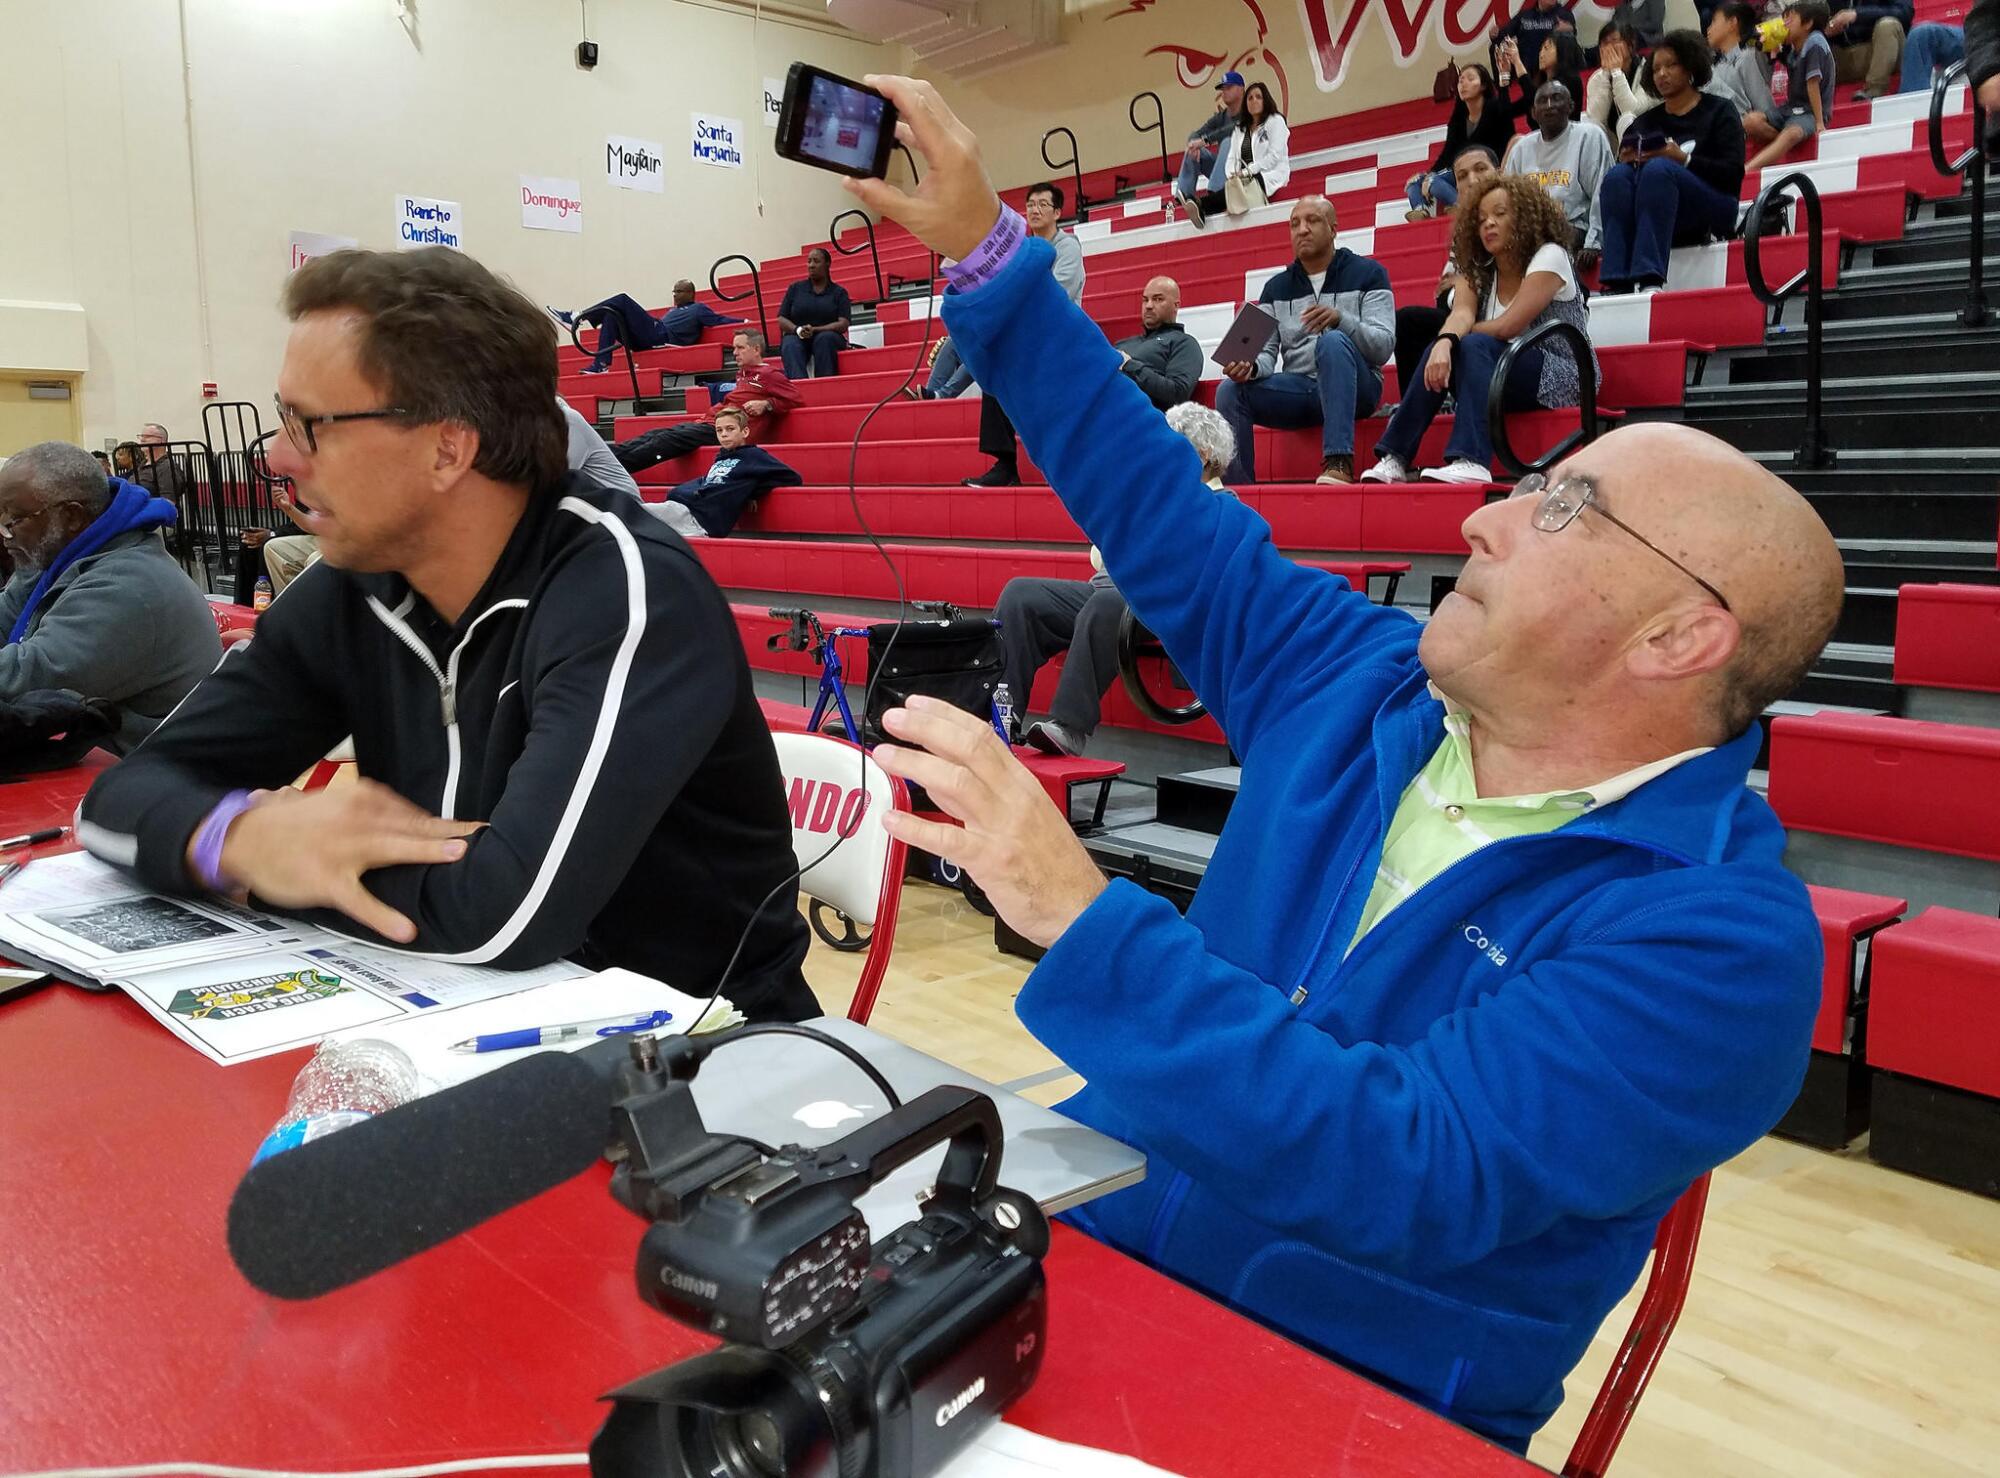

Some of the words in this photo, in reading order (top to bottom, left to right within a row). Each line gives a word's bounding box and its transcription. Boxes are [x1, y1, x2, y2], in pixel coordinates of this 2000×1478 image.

[697, 119, 732, 144] Santa
[607, 143, 661, 177] Mayfair
[693, 139, 741, 164] Margarita
[405, 199, 451, 223] Rancho
[401, 221, 458, 247] Christian
[219, 1001, 277, 1019] BEACH
[660, 1265, 719, 1300] Canon
[935, 1376, 985, 1427] Canon
